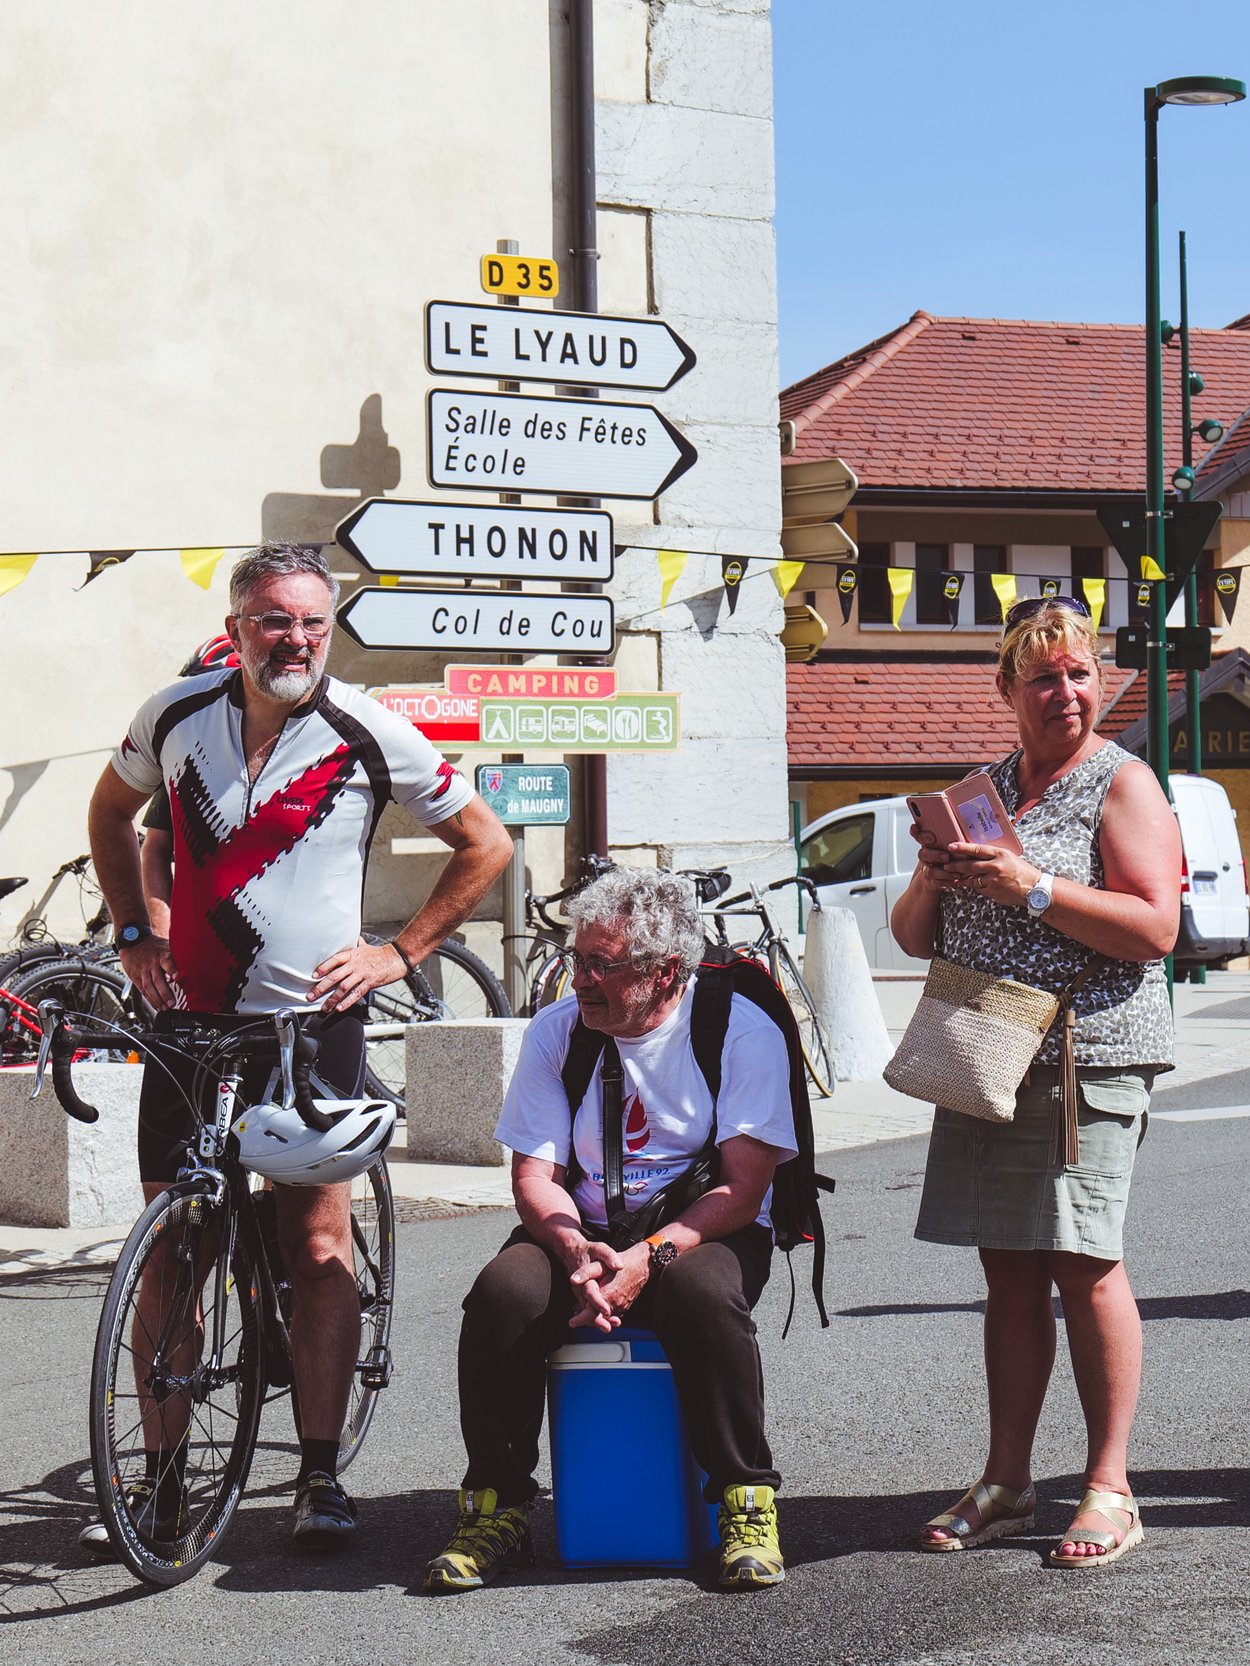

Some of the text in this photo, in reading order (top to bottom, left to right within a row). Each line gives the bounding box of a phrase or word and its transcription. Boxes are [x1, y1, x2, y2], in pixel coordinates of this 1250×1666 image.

[488, 260, 554, 291] D 35
[444, 321, 638, 369] LE LYAUD
[445, 406, 647, 447] Salle des Fêtes
[445, 436, 527, 476] École
[427, 522, 598, 562] THONON
[432, 607, 603, 638] Col de Cou
[467, 673, 600, 694] CAMPING
[1173, 730, 1250, 752] ARIE
[518, 776, 554, 791] ROUTE
[507, 799, 564, 813] de MAUGNY
